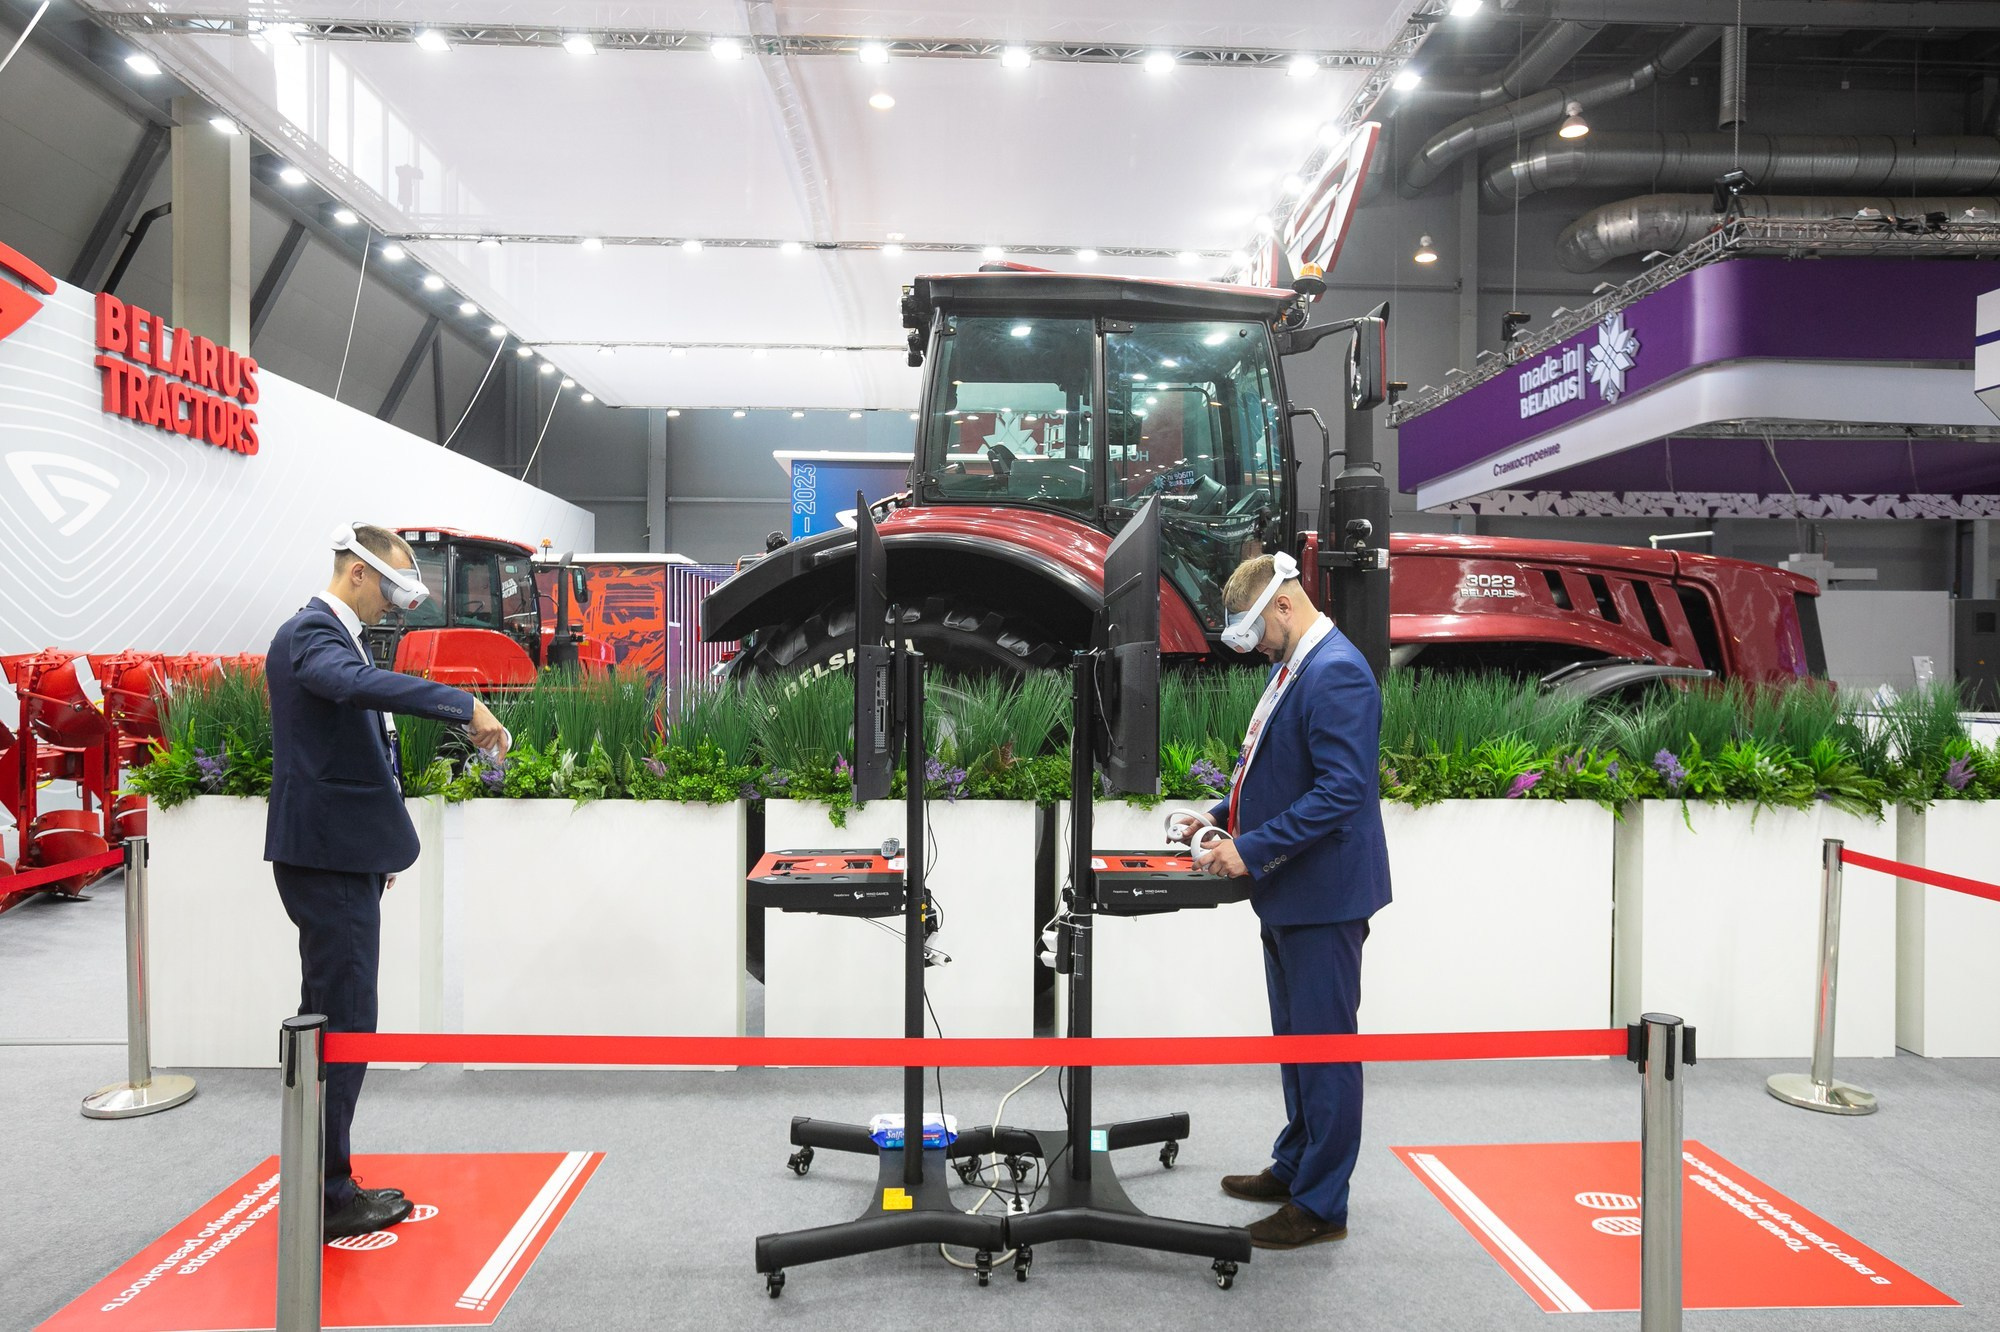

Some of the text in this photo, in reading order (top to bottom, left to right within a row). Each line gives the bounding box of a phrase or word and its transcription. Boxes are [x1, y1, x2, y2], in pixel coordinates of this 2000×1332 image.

[96, 292, 259, 405] BELARUS
[1519, 347, 1578, 394] made in
[96, 354, 260, 456] TRACTORS
[1520, 376, 1578, 419] BELARUS
[1493, 443, 1561, 477] Станкостроение
[1460, 588, 1515, 598] BELARUS
[1466, 574, 1516, 588] 3023
[176, 1220, 256, 1275] перехода
[1756, 1203, 1875, 1275] виртуальную
[1757, 1220, 1810, 1252] Точка
[100, 1238, 205, 1312] реальность
[1869, 1275, 1892, 1285] в
